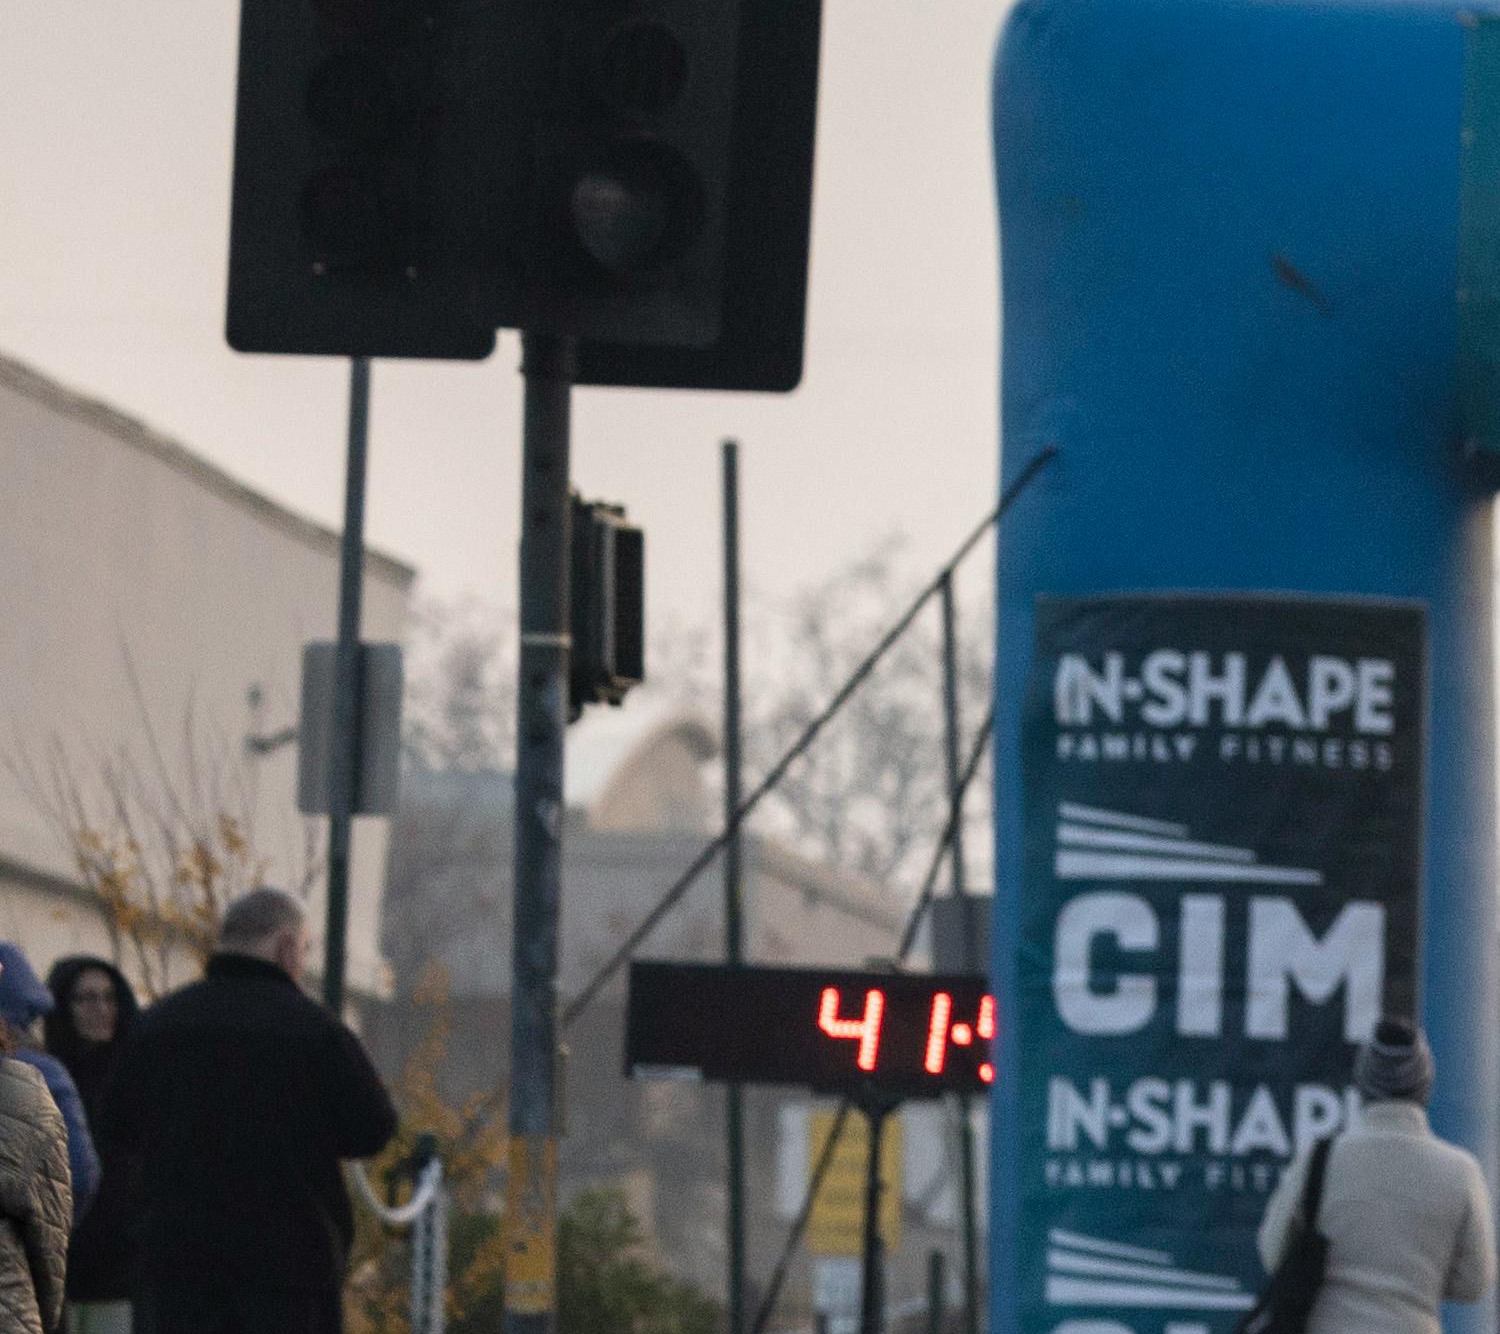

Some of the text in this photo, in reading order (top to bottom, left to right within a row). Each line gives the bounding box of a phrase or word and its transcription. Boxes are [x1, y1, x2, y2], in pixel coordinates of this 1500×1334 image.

[1055, 731, 1394, 771] FAMILY FITNESS
[1053, 889, 1388, 1045] CIM
